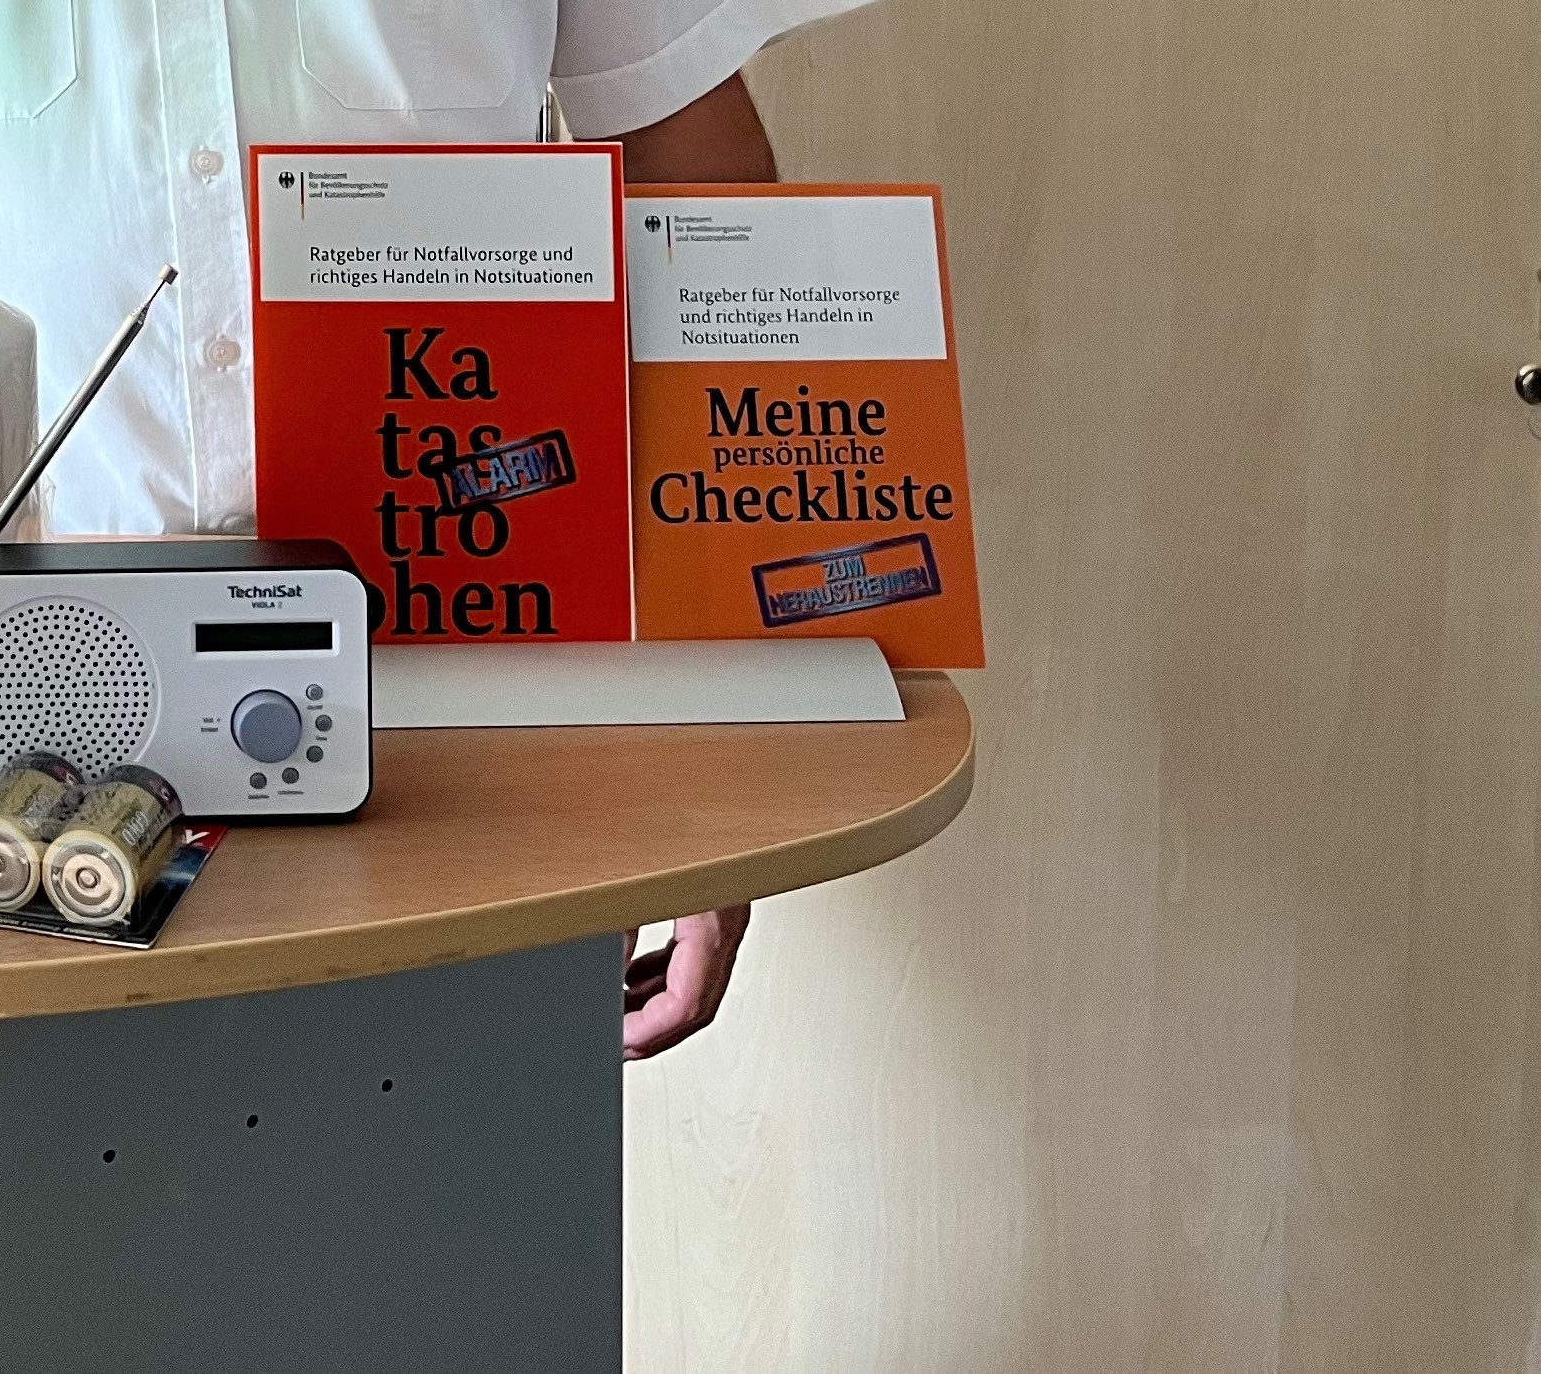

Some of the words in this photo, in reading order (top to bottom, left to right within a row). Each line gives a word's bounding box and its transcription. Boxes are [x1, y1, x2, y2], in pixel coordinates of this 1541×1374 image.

[309, 246, 381, 265] Ratgeber
[387, 246, 408, 262] für
[414, 246, 538, 265] Notfallvorsorge
[543, 246, 573, 262] und
[309, 268, 377, 287] richtiges
[383, 268, 450, 284] Handeln
[454, 268, 469, 284] in
[475, 268, 594, 285] Notsituationen
[679, 287, 747, 305] Ratgeber
[752, 287, 775, 302] für
[779, 286, 901, 305] Notfallvorsorge
[680, 309, 711, 324] und
[716, 309, 782, 326] richtiges
[787, 308, 853, 323] Handeln
[858, 308, 874, 322] in
[682, 330, 800, 345] Notsituationen
[383, 327, 499, 401] Ka
[705, 385, 887, 437] Meine
[713, 438, 885, 473] persönliche
[650, 469, 955, 524] Checkliste
[374, 491, 510, 558] tro
[227, 585, 302, 599] TechniSat
